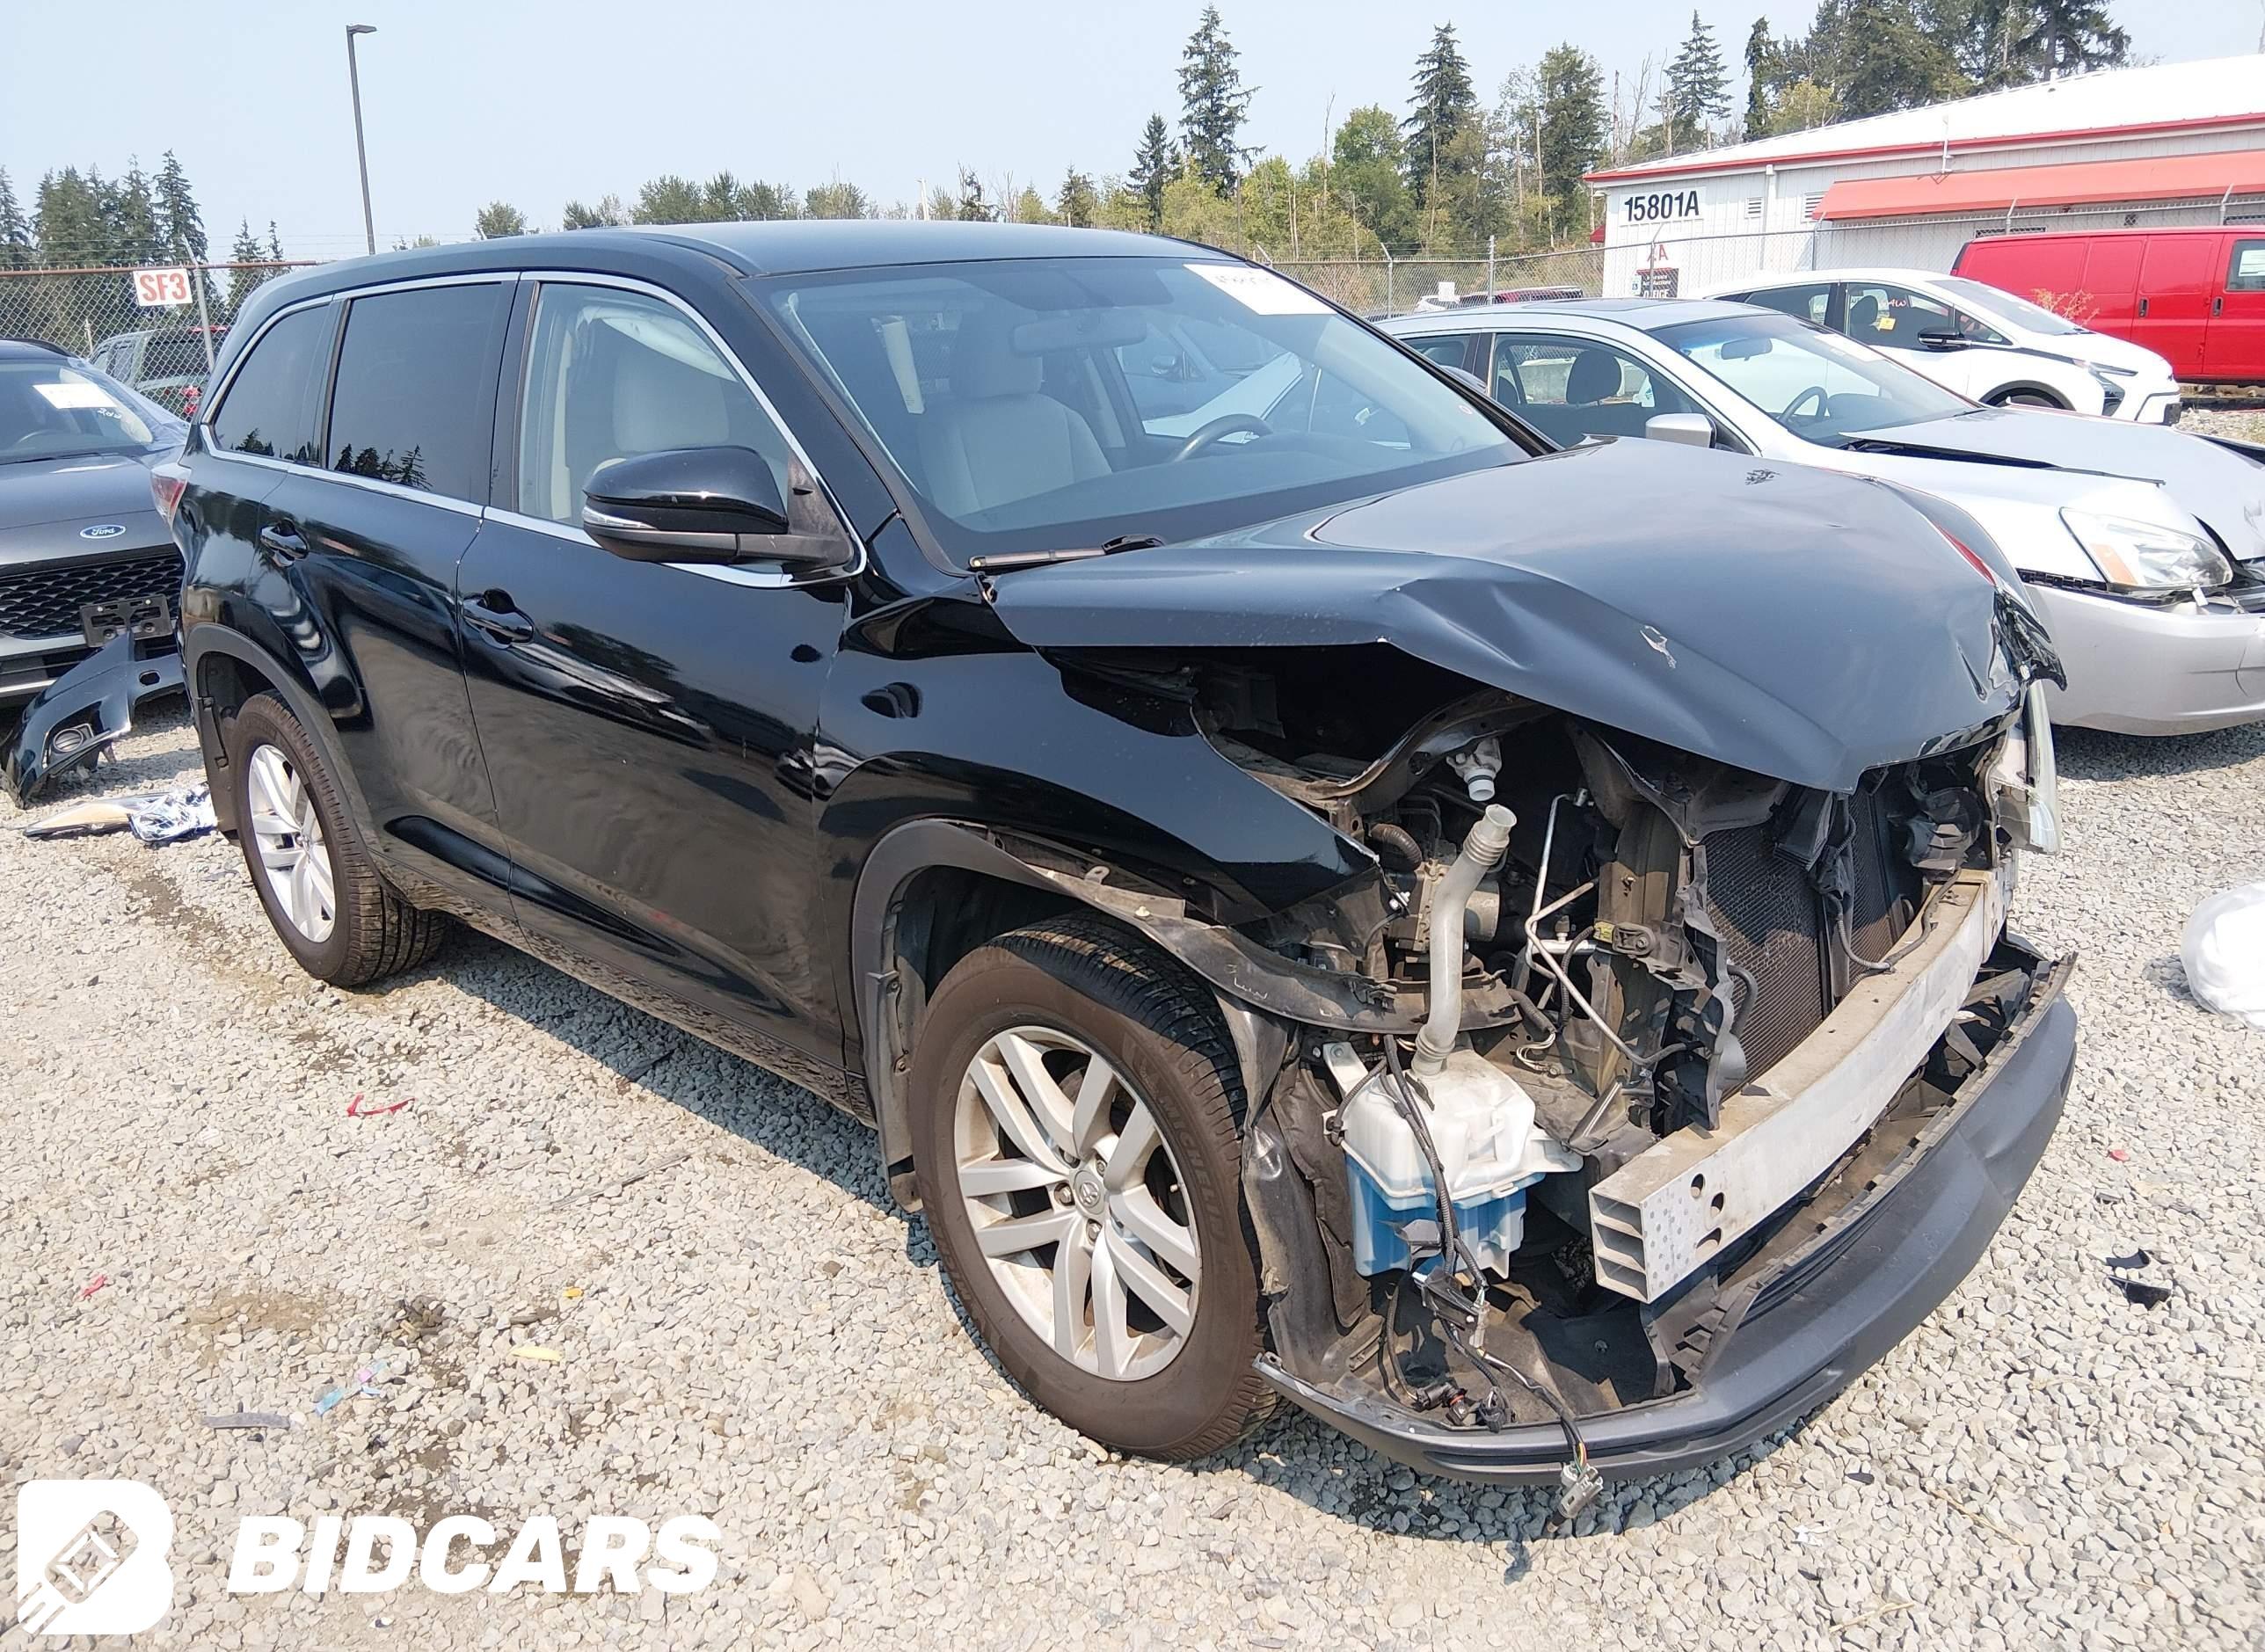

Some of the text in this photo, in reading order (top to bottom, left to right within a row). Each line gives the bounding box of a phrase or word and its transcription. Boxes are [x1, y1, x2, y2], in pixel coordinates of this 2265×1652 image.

[1624, 190, 1700, 222] 15801A
[139, 273, 186, 302] SF3
[91, 526, 115, 535] Ford
[1158, 1095, 1227, 1242] MICHELIN
